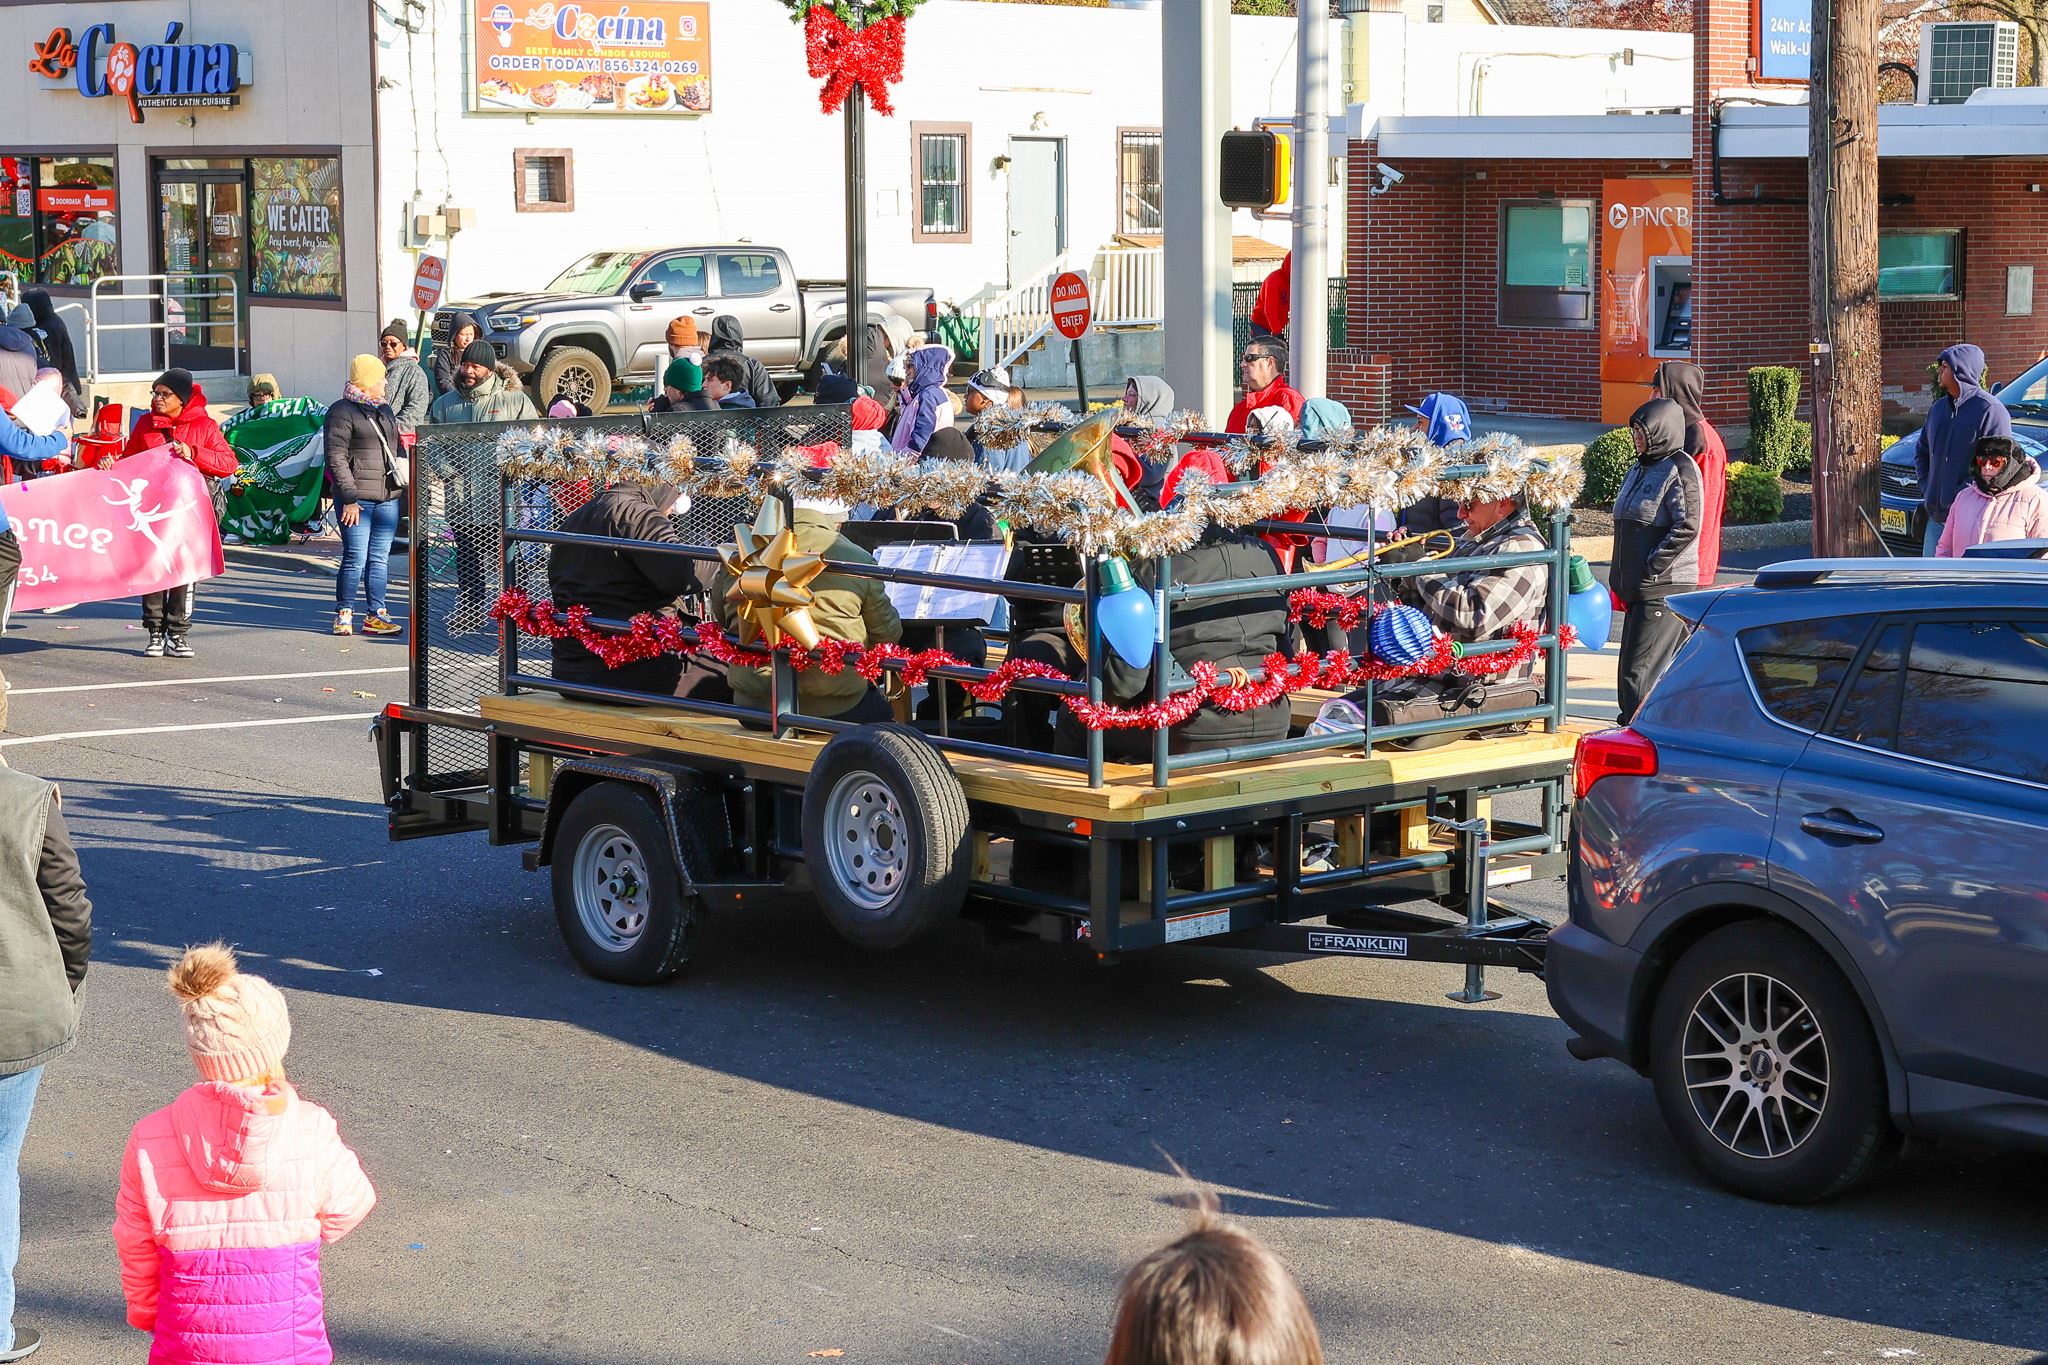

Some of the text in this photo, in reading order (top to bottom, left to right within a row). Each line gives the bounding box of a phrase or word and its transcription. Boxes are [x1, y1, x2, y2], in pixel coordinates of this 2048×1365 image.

[1770, 17, 1796, 32] 24hr
[30, 27, 77, 79] La
[525, 46, 671, 59] BEST FAMILY COMBOS AROUND!
[1770, 40, 1810, 56] Walk-U
[490, 56, 697, 73] ORDER TODAY! 856.324.0269
[138, 97, 230, 107] AUTHENTIC LATIN CUISINE
[56, 197, 82, 206] DOORDASH
[267, 204, 330, 233] WE CATER
[1630, 206, 1693, 228] PNC B
[268, 234, 282, 251] Any
[302, 235, 316, 253] Any
[422, 265, 441, 278] DO NOT
[417, 290, 434, 300] ENTER
[1056, 284, 1081, 297] DO NOT
[1061, 314, 1084, 327] ENTER
[1324, 935, 1403, 951] FRANKLIN
